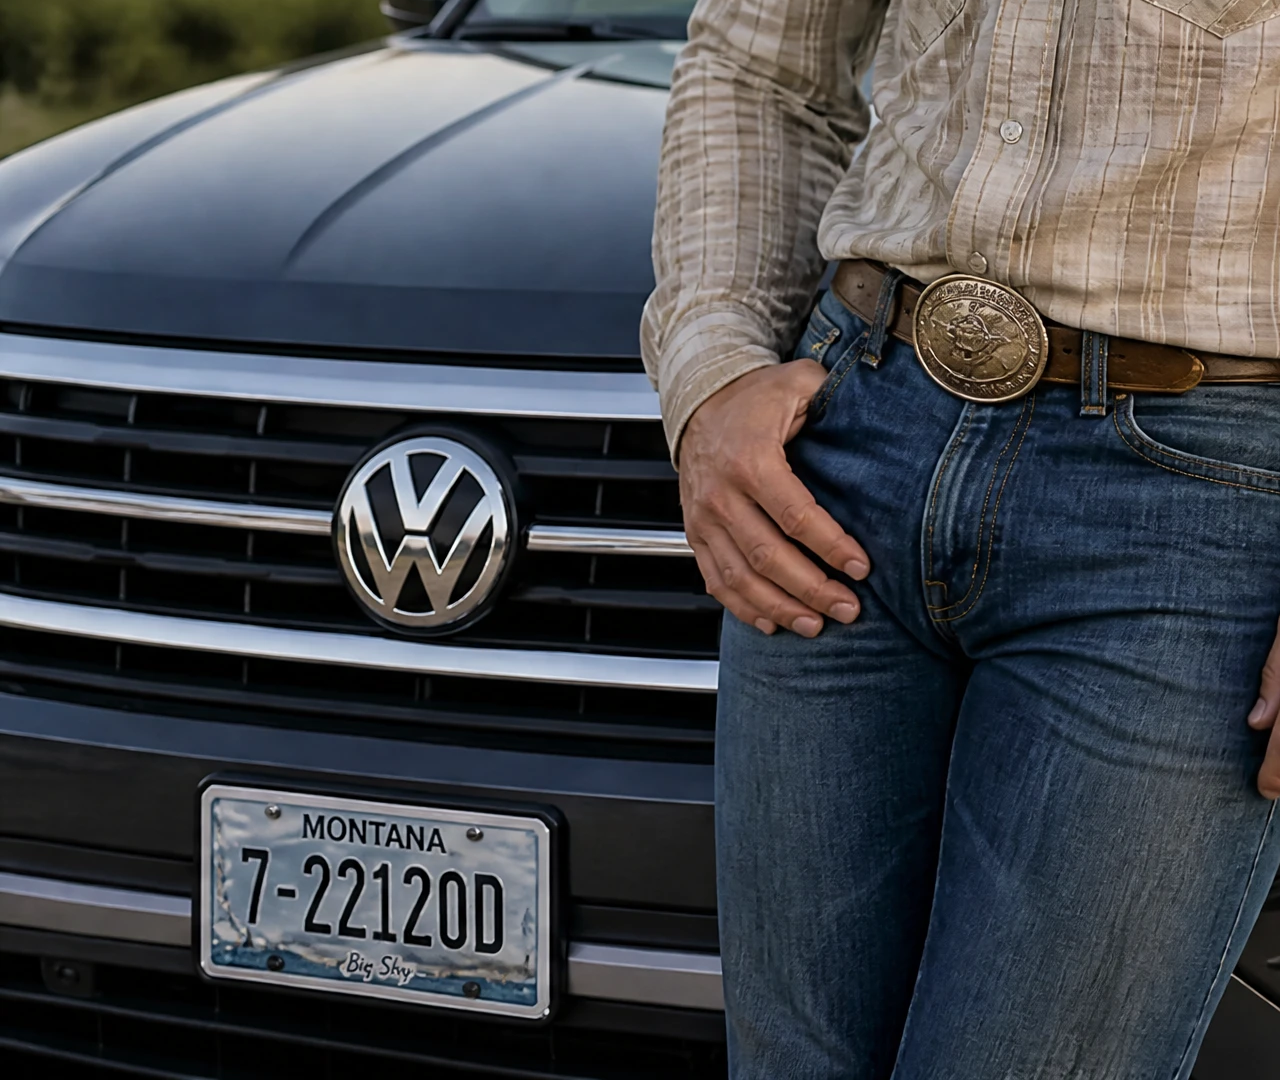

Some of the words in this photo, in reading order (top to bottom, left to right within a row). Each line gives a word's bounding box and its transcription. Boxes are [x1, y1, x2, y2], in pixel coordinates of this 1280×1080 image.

[338, 437, 508, 627] VW
[302, 814, 446, 854] MONTANA
[242, 848, 503, 954] 7-22120D
[346, 952, 373, 979] Big
[379, 956, 411, 982] Sky
